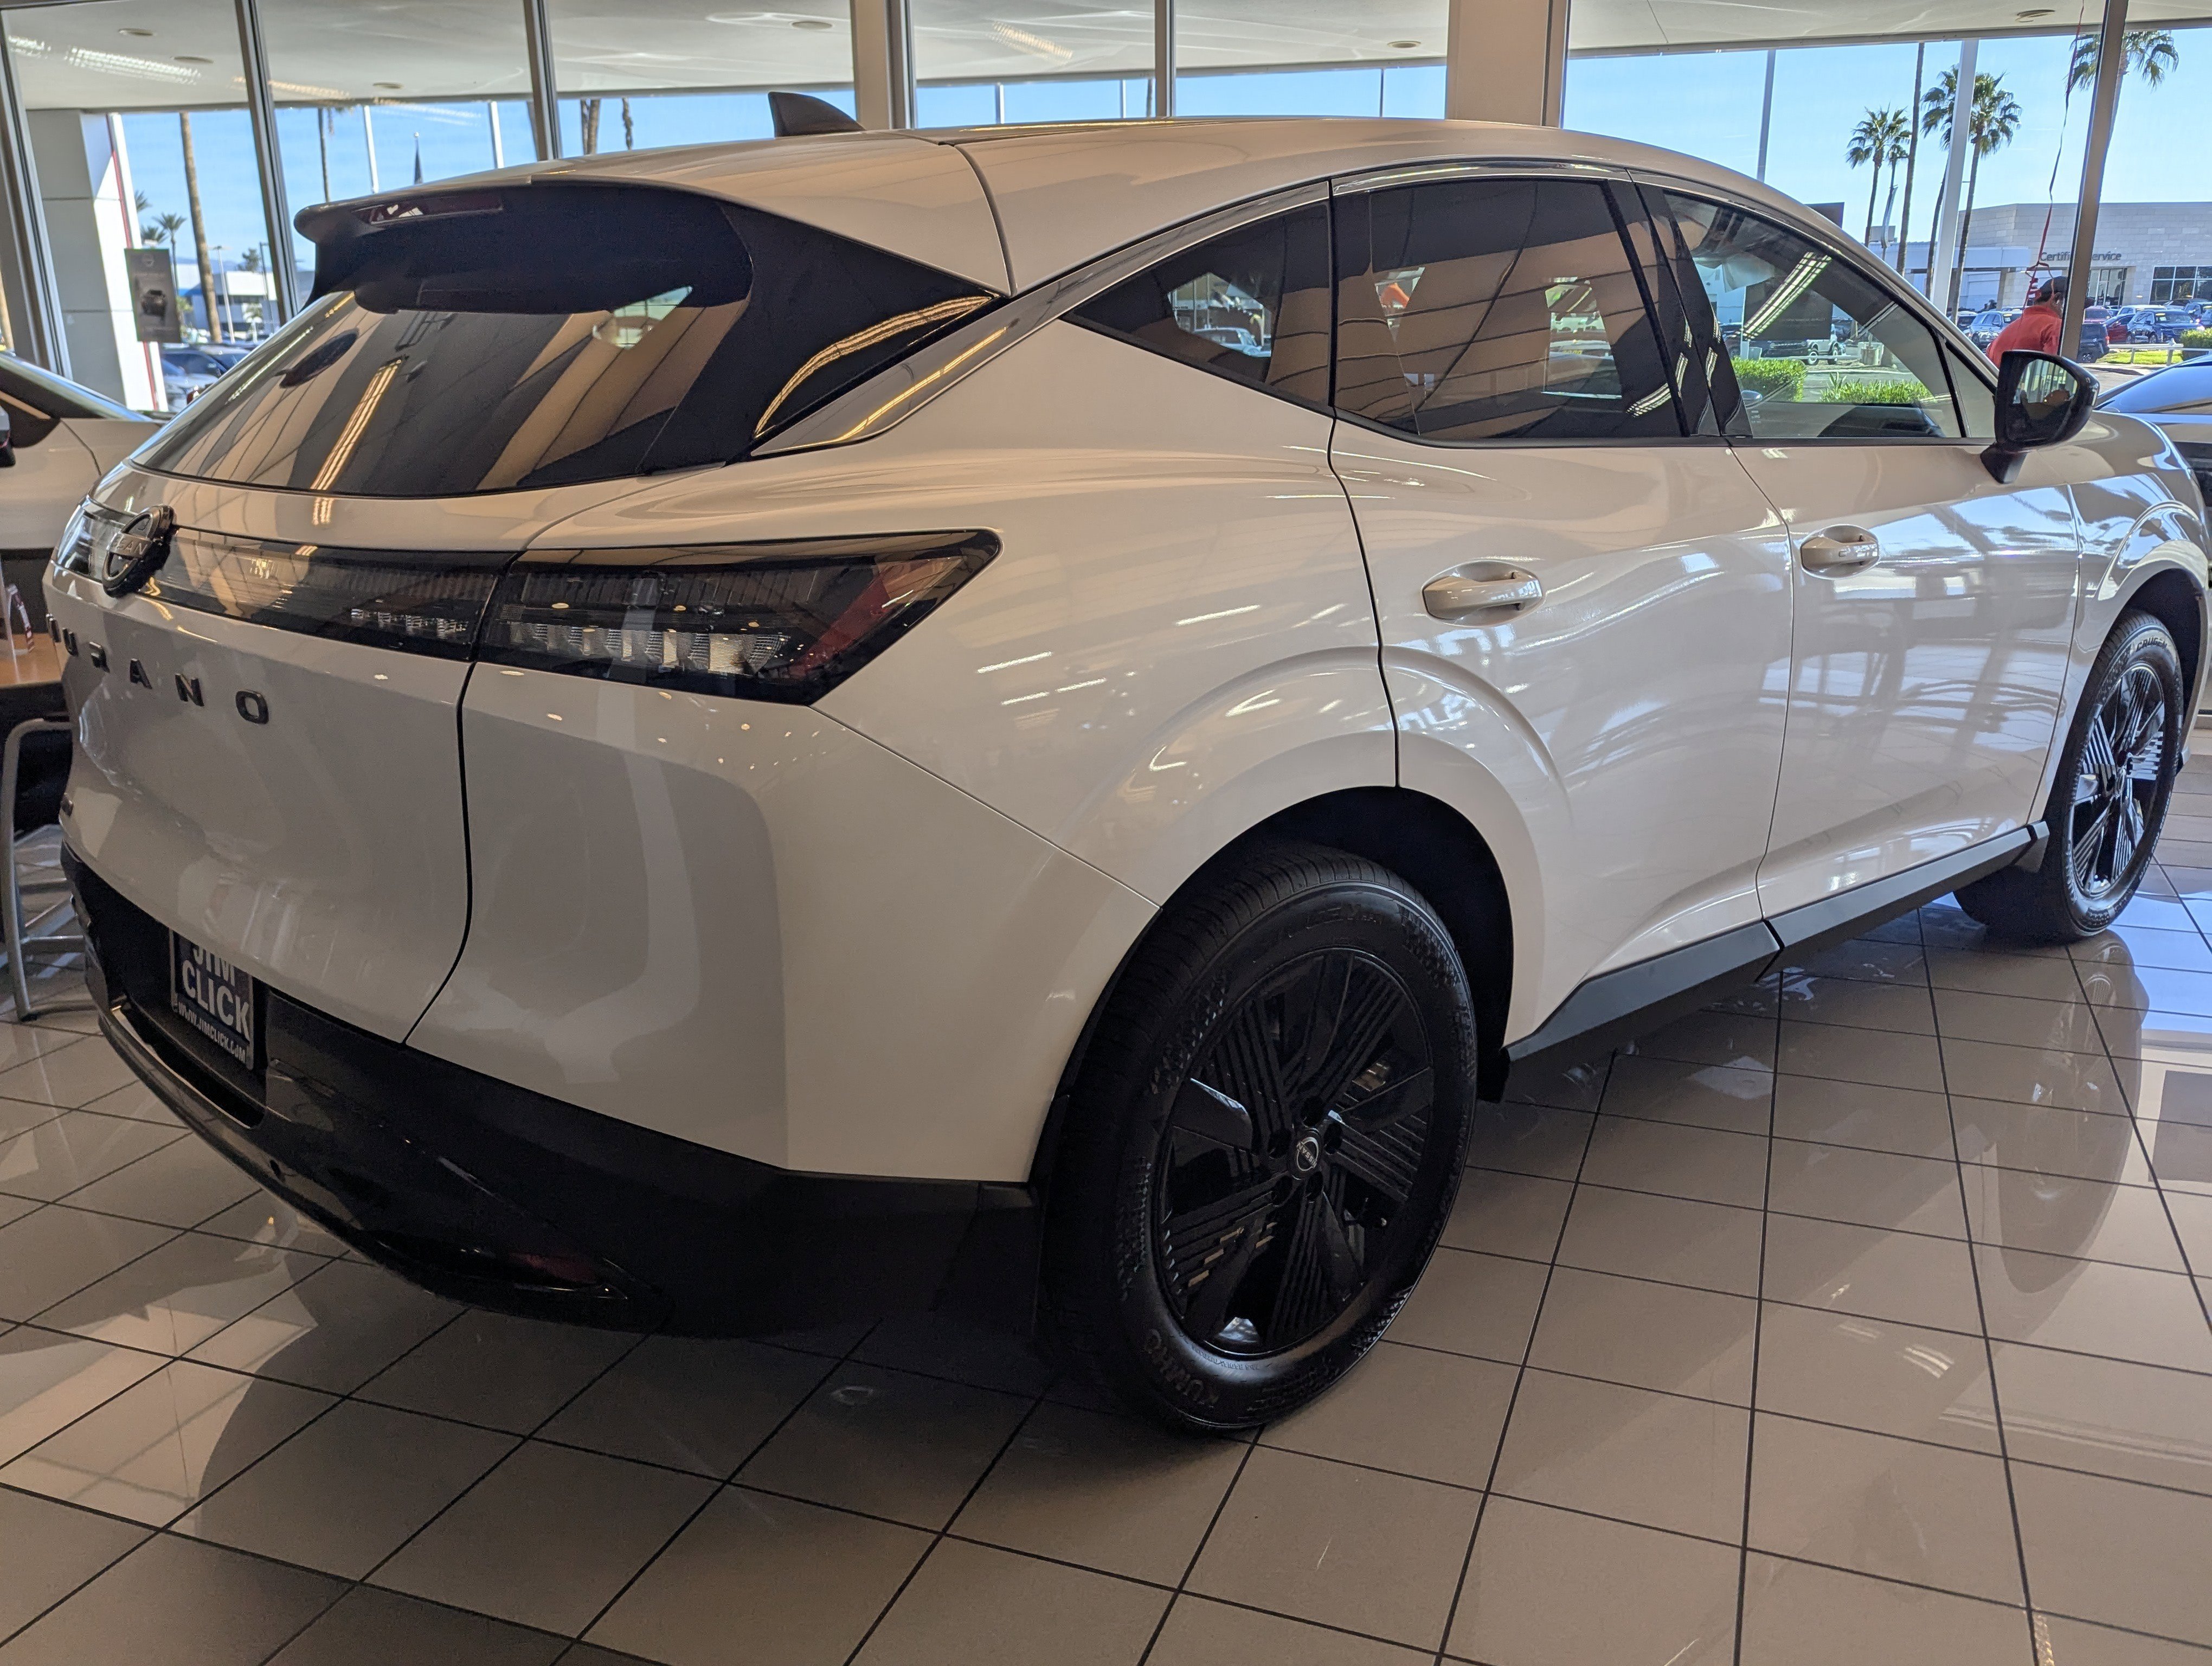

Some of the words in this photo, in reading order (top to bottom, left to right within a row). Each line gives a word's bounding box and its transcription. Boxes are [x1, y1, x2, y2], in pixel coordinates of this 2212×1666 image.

[2040, 251, 2070, 261] Certifi
[2092, 251, 2122, 261] ervice
[182, 959, 250, 1042] CLICK
[1296, 1141, 1317, 1169] NISSAN
